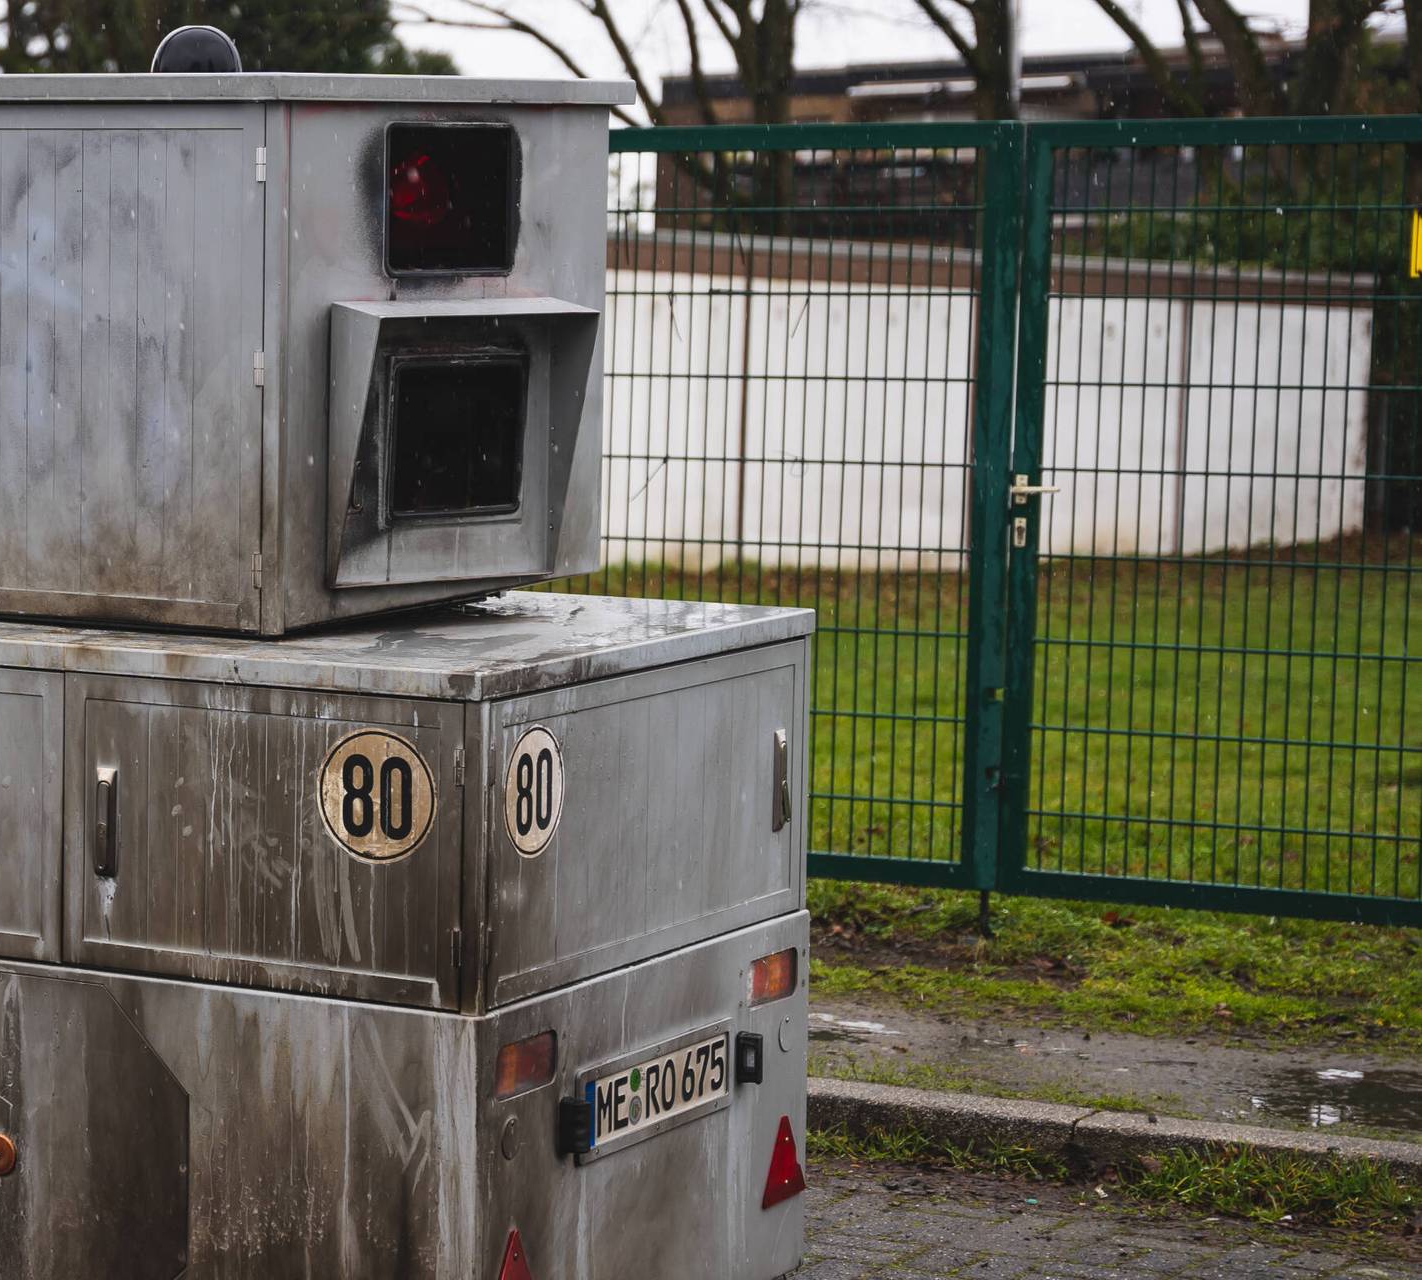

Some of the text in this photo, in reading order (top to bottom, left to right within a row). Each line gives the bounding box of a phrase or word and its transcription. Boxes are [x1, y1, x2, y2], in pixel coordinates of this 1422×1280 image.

[342, 753, 413, 841] 80
[516, 747, 553, 837] 80
[596, 1039, 725, 1139] ME RO 675
